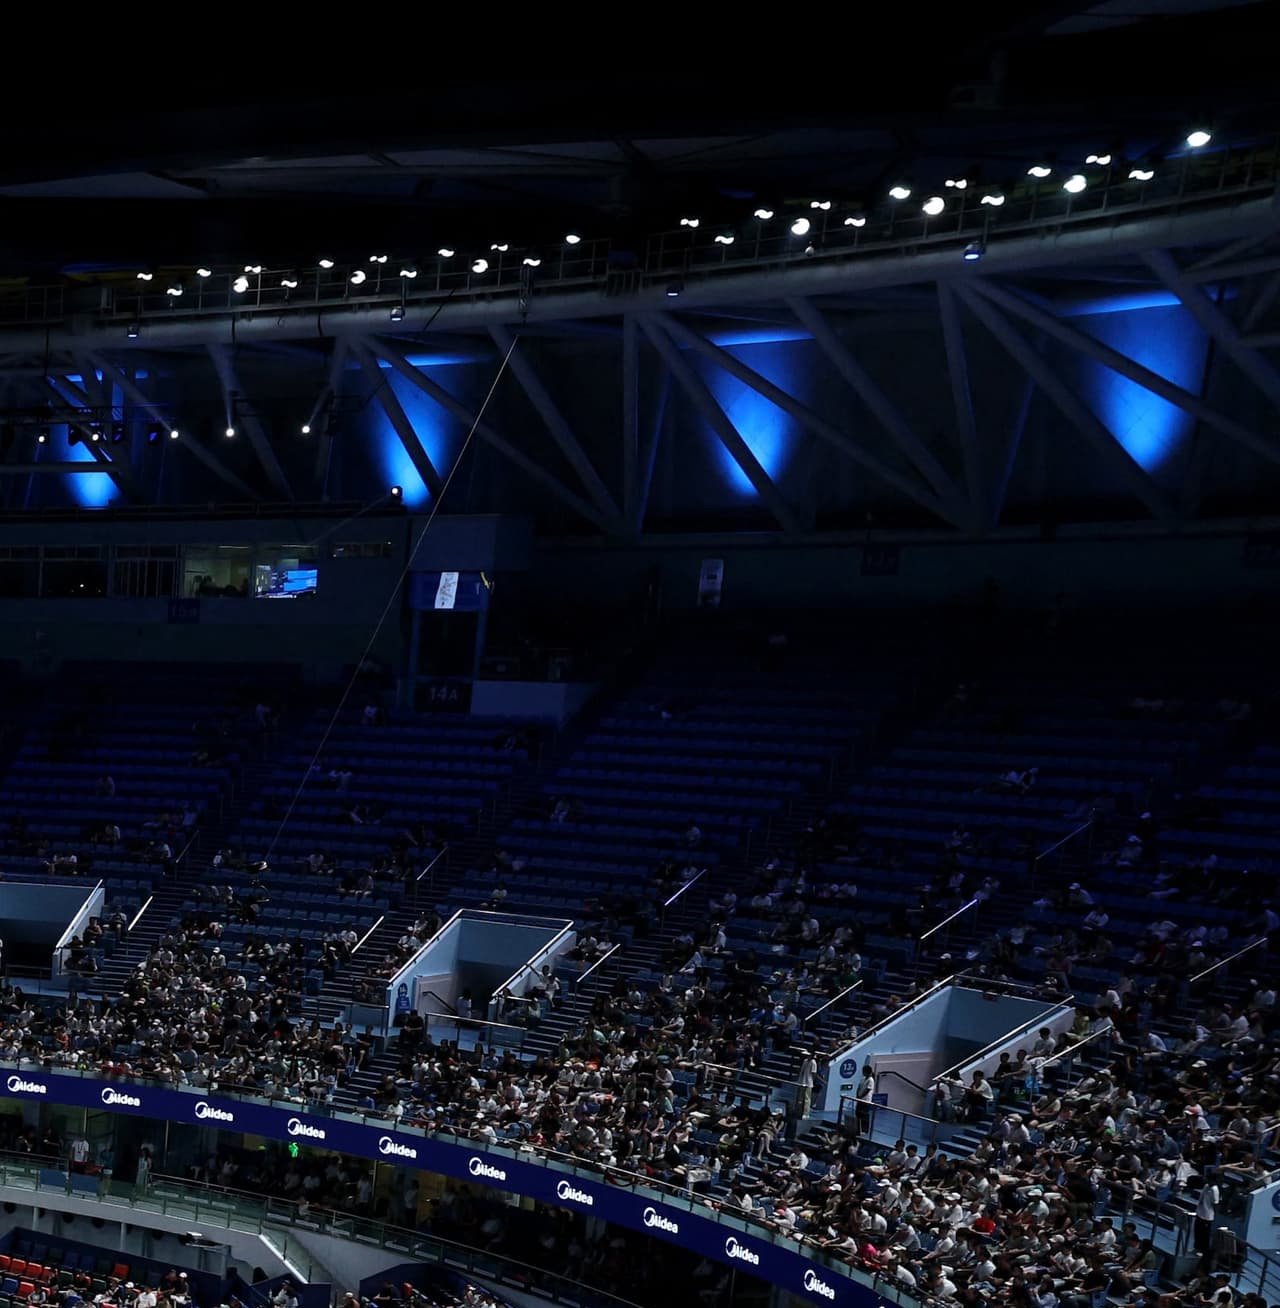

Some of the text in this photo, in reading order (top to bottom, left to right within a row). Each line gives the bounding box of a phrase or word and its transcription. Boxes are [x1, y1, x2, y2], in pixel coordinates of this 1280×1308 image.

[7, 1076, 46, 1093] Midea
[102, 1088, 140, 1106] Midea
[195, 1102, 233, 1121] Midea
[288, 1118, 325, 1139] Midea
[379, 1137, 417, 1158] Midea
[469, 1157, 506, 1180] Midea
[557, 1181, 593, 1205] Midea
[644, 1207, 678, 1233] Midea
[726, 1237, 759, 1265] Midea
[804, 1270, 835, 1300] Midea
